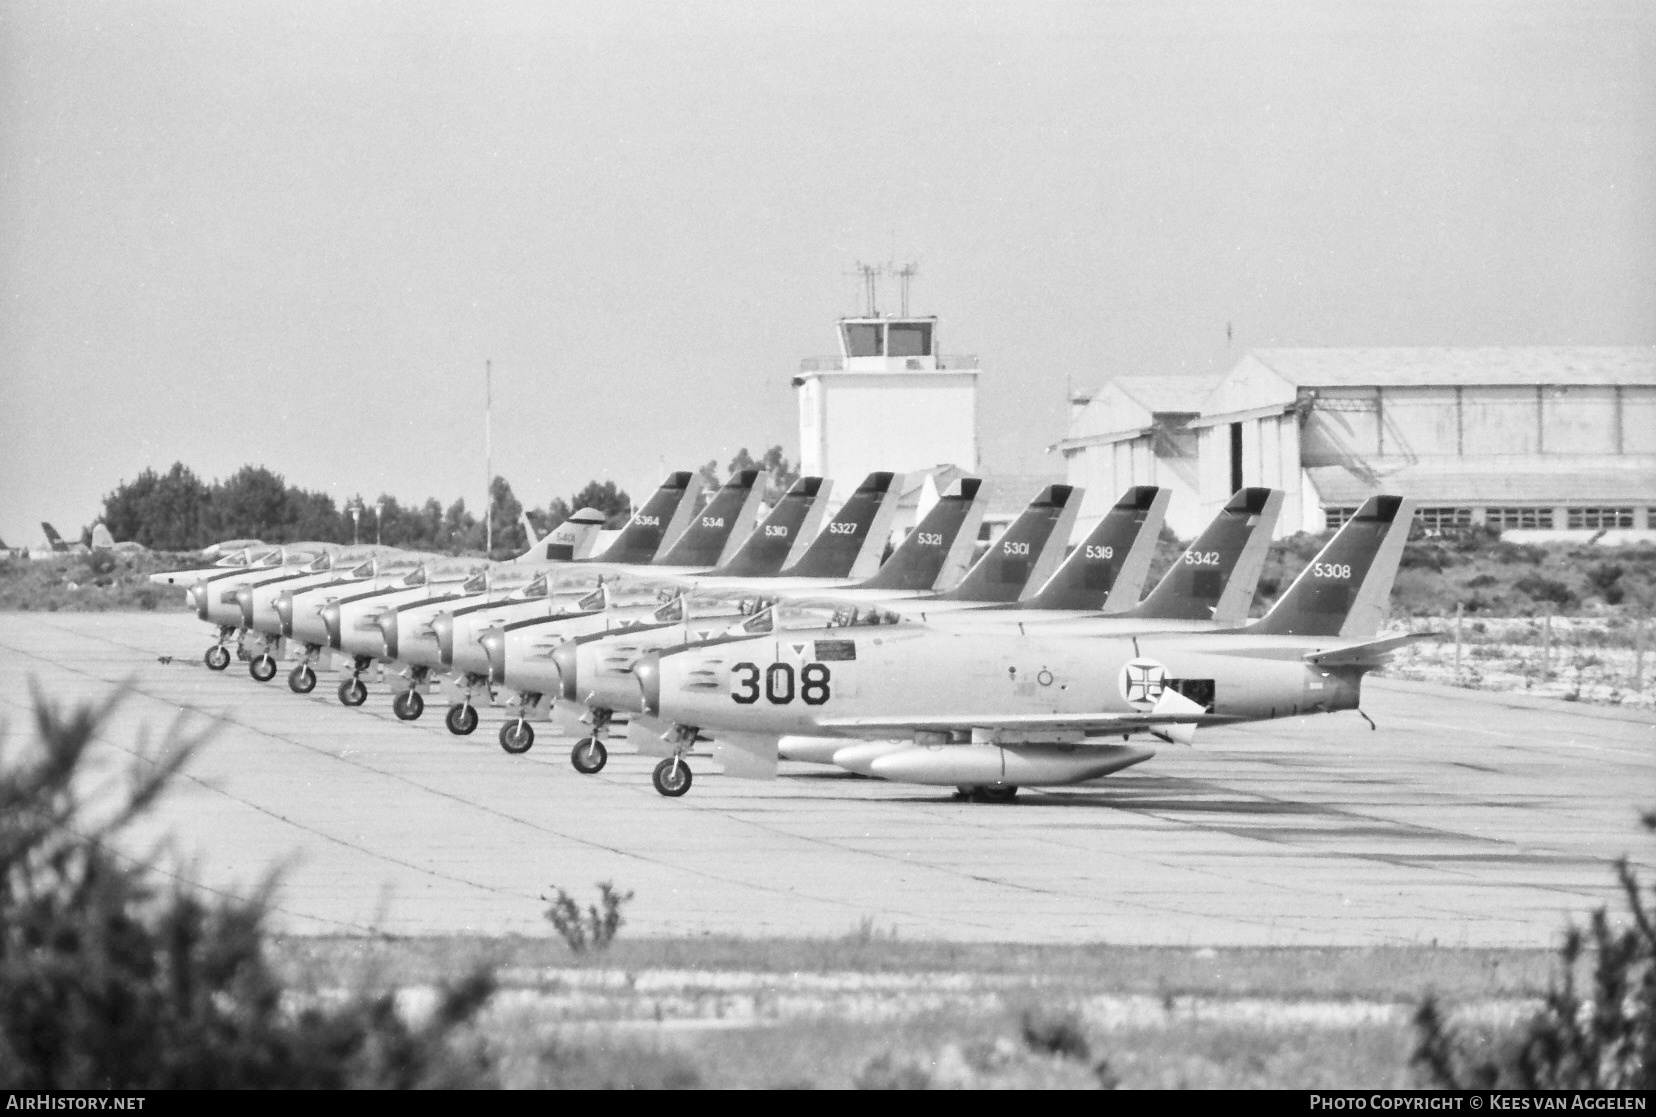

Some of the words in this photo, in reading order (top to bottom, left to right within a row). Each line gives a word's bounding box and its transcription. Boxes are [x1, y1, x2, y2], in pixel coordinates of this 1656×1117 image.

[702, 516, 724, 527] 5341
[765, 525, 787, 537] 5310
[830, 523, 857, 535] 5327
[917, 532, 942, 545] 5321
[1004, 541, 1029, 555] 5301
[1086, 545, 1113, 559] 5319
[1185, 551, 1219, 566] 5342
[1314, 563, 1351, 579] 5308
[731, 662, 830, 705] 308
